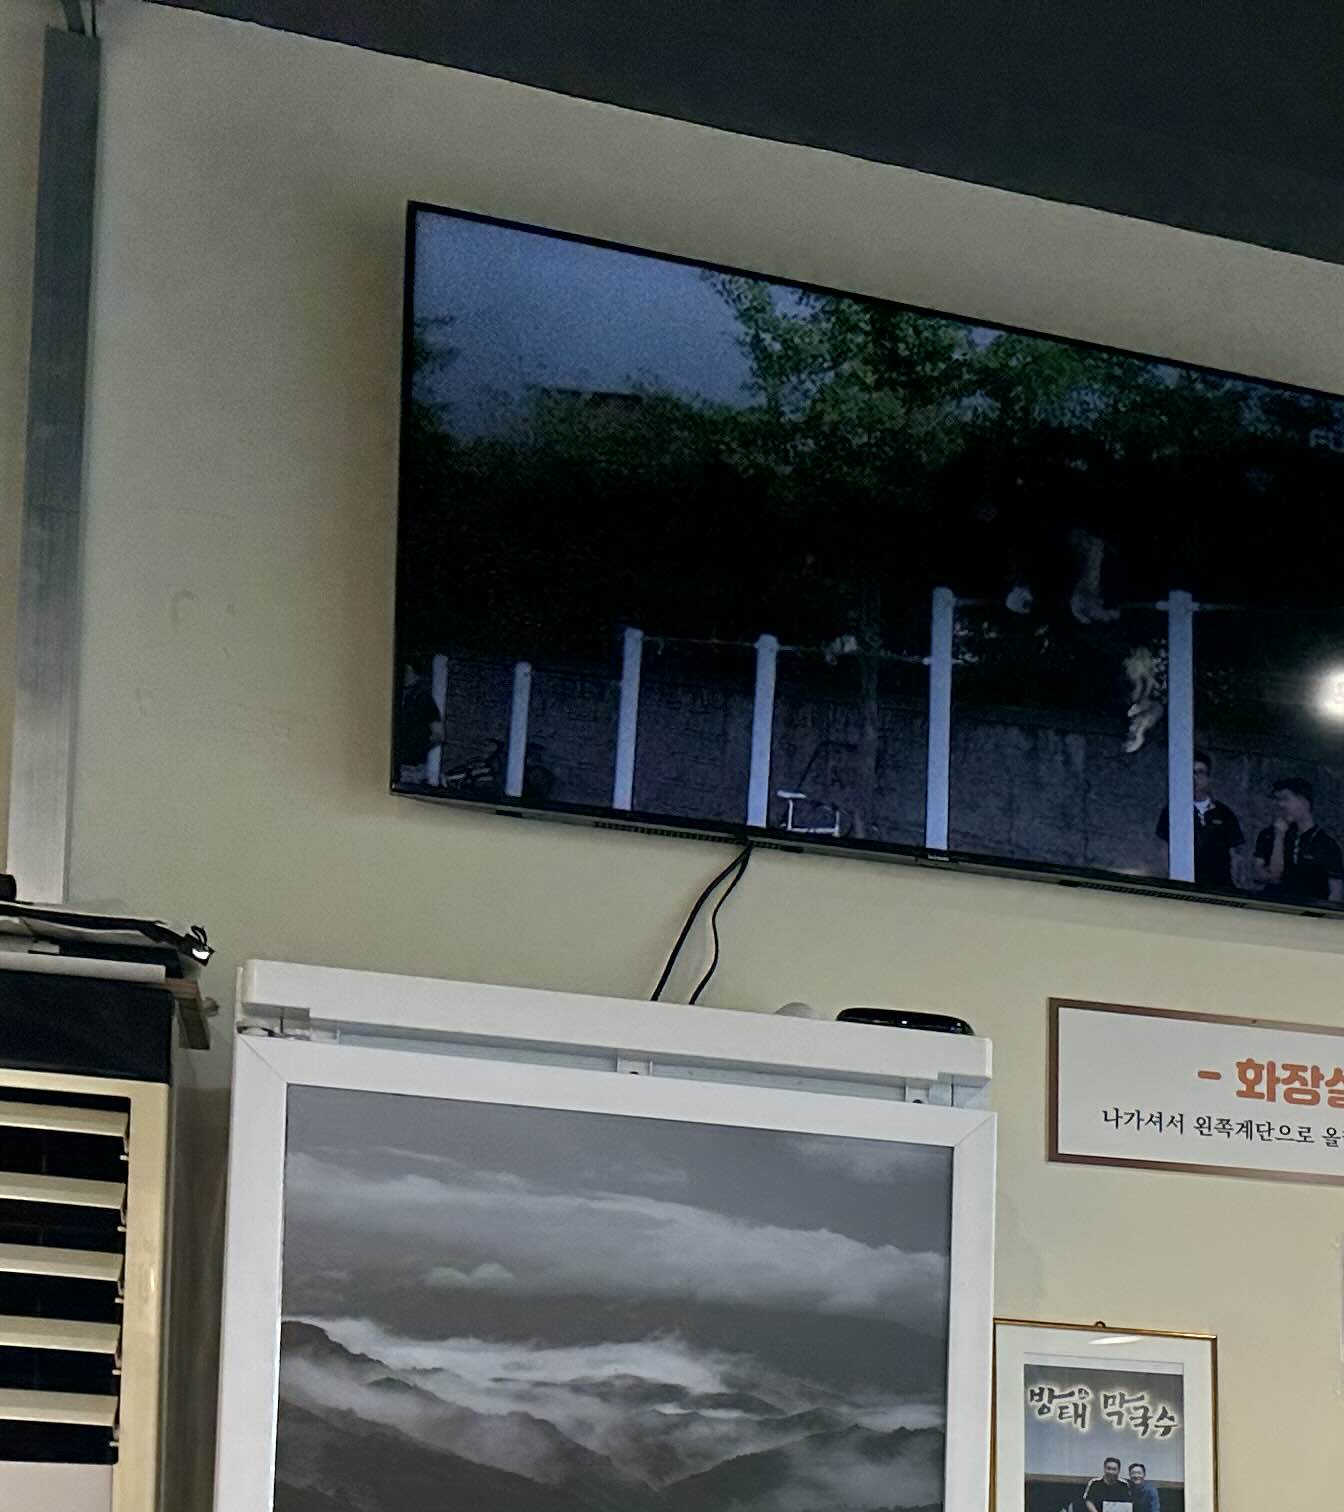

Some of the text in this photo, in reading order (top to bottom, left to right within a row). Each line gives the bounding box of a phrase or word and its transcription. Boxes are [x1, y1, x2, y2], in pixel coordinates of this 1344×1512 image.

[1102, 1108, 1185, 1136] 나가셔서
[1193, 1115, 1316, 1146] 왼쪽계단으로
[1029, 1385, 1179, 1438] 방태 막국수
